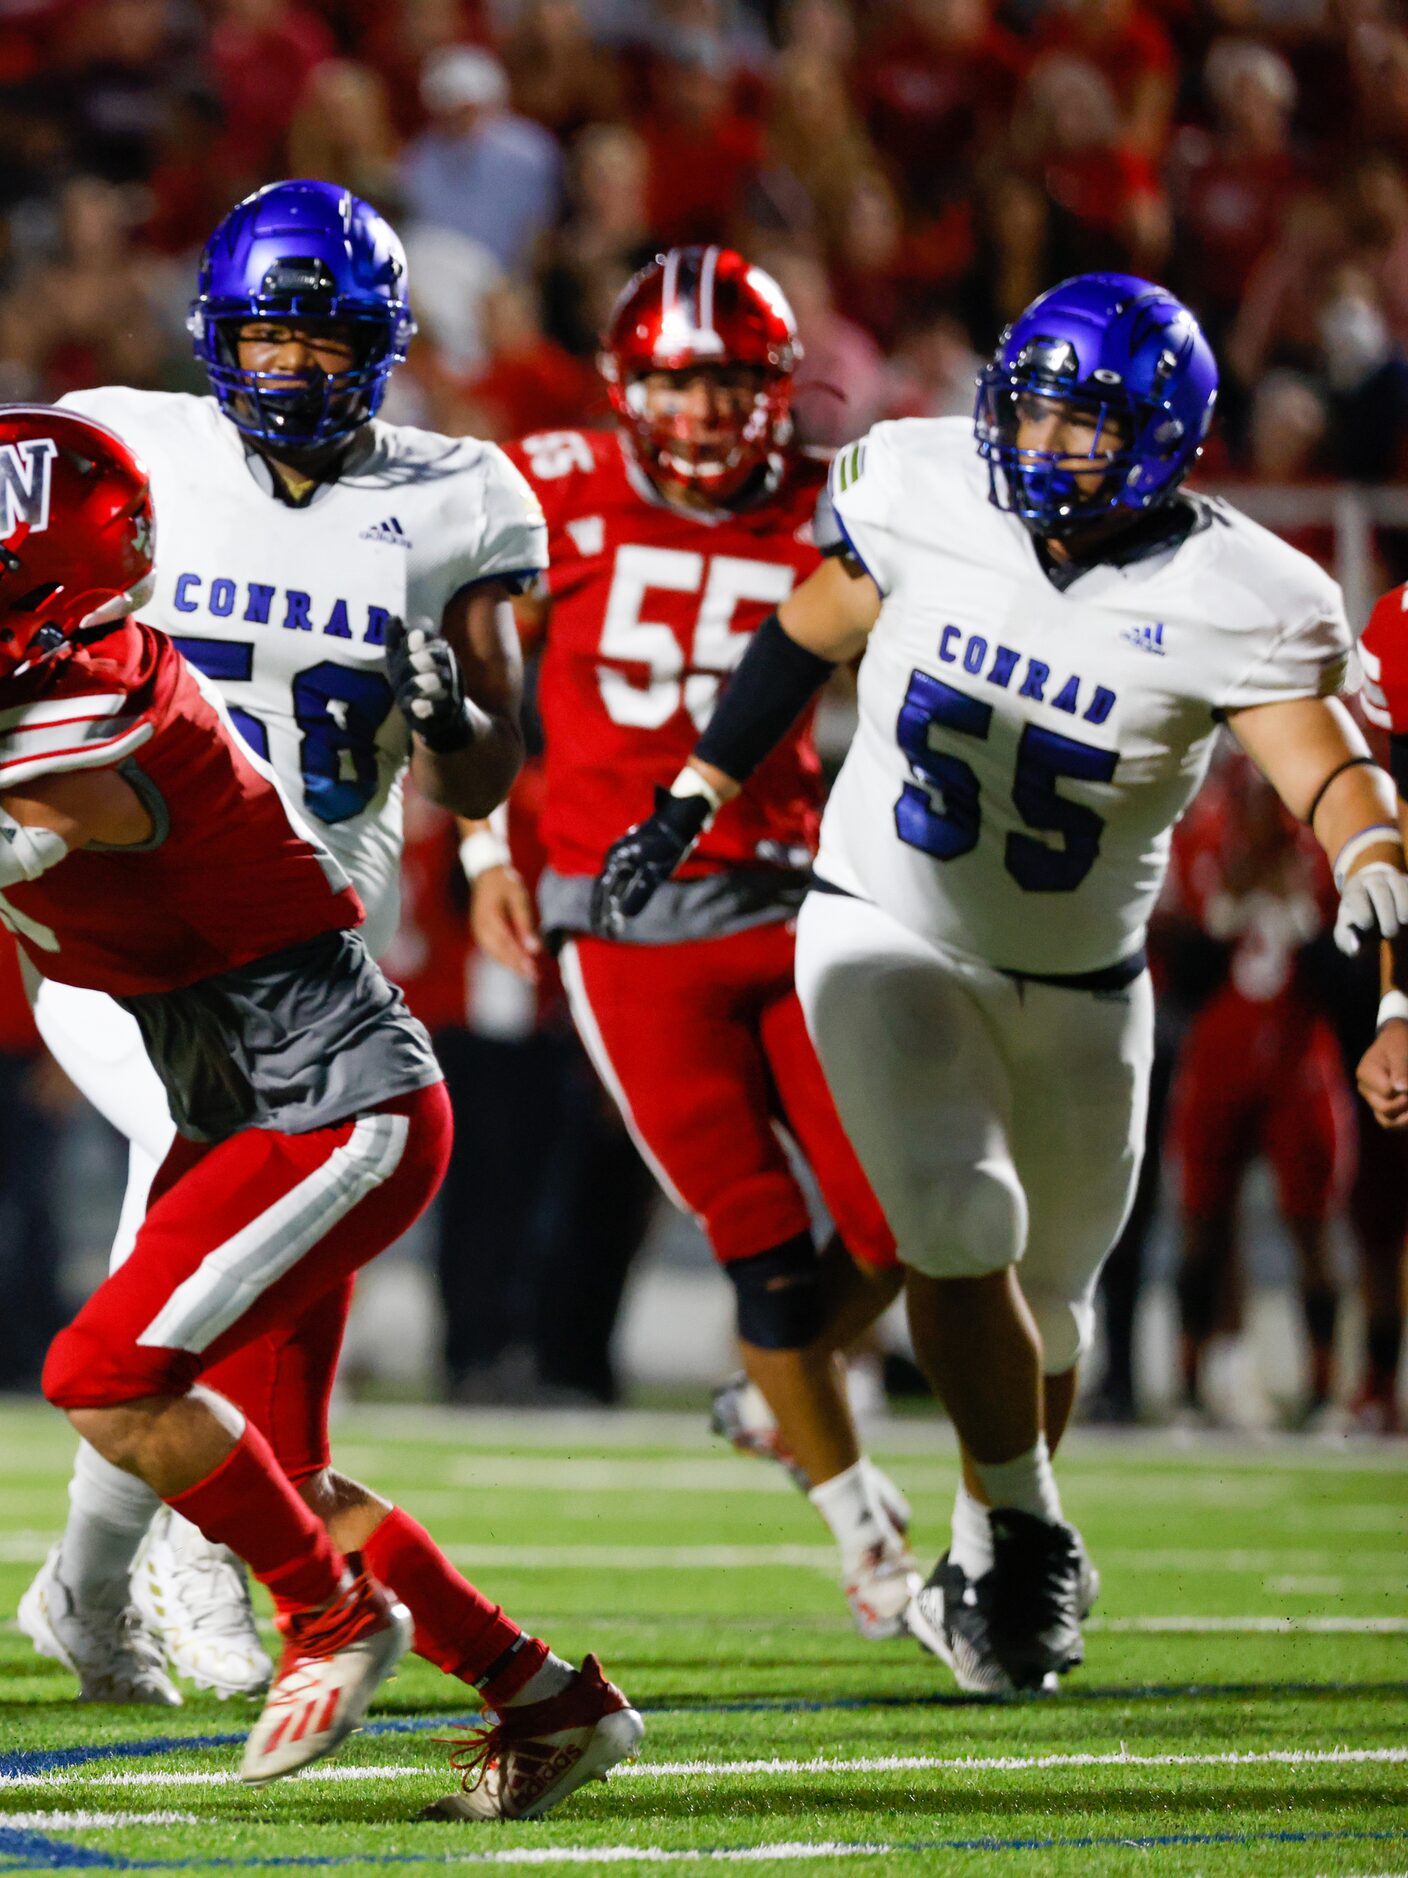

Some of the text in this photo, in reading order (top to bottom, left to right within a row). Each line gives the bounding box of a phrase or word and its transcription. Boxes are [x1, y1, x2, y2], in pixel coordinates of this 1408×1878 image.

[174, 573, 391, 646] CONRAD
[938, 624, 1117, 725] CONRAD
[893, 668, 1121, 893] 55
